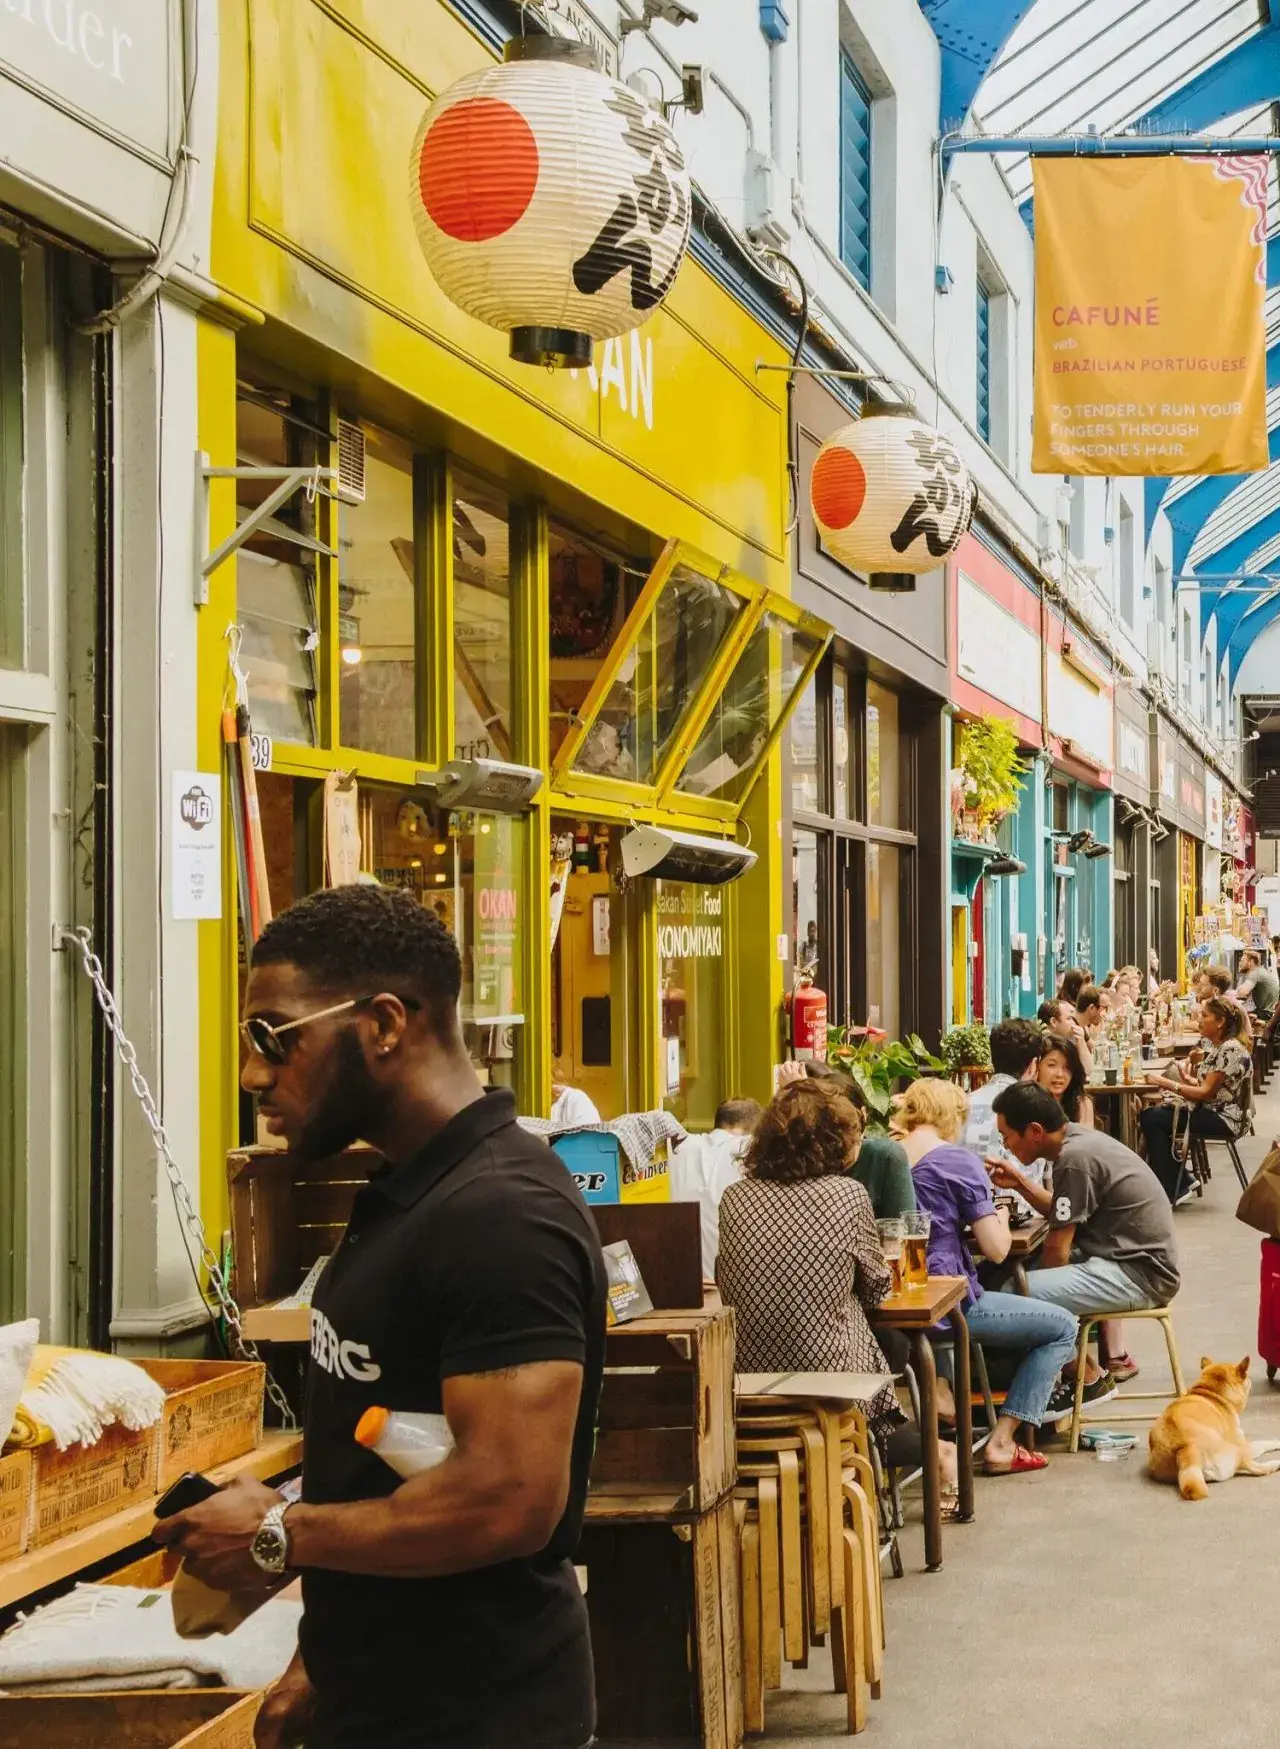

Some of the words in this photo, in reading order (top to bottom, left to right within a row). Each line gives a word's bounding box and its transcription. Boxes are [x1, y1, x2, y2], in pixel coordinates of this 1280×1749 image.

[1052, 297, 1159, 327] CAFUNÉ
[1053, 358, 1136, 375] BRAZILIAN
[1140, 356, 1247, 372] PORTUGUESE
[1052, 403, 1072, 419] TO
[1075, 403, 1158, 418] TENDERLY
[1161, 403, 1196, 417] RUN
[1200, 402, 1243, 417] YOUR
[1051, 423, 1115, 438] FINGERS
[1120, 423, 1199, 437] THROUGH
[1051, 443, 1141, 458] SOMEONE'S
[251, 735, 270, 768] 39
[479, 888, 517, 919] OKAN
[703, 890, 721, 915] Food
[658, 925, 722, 958] KONOMIYAKI
[1056, 1196, 1071, 1221] 8
